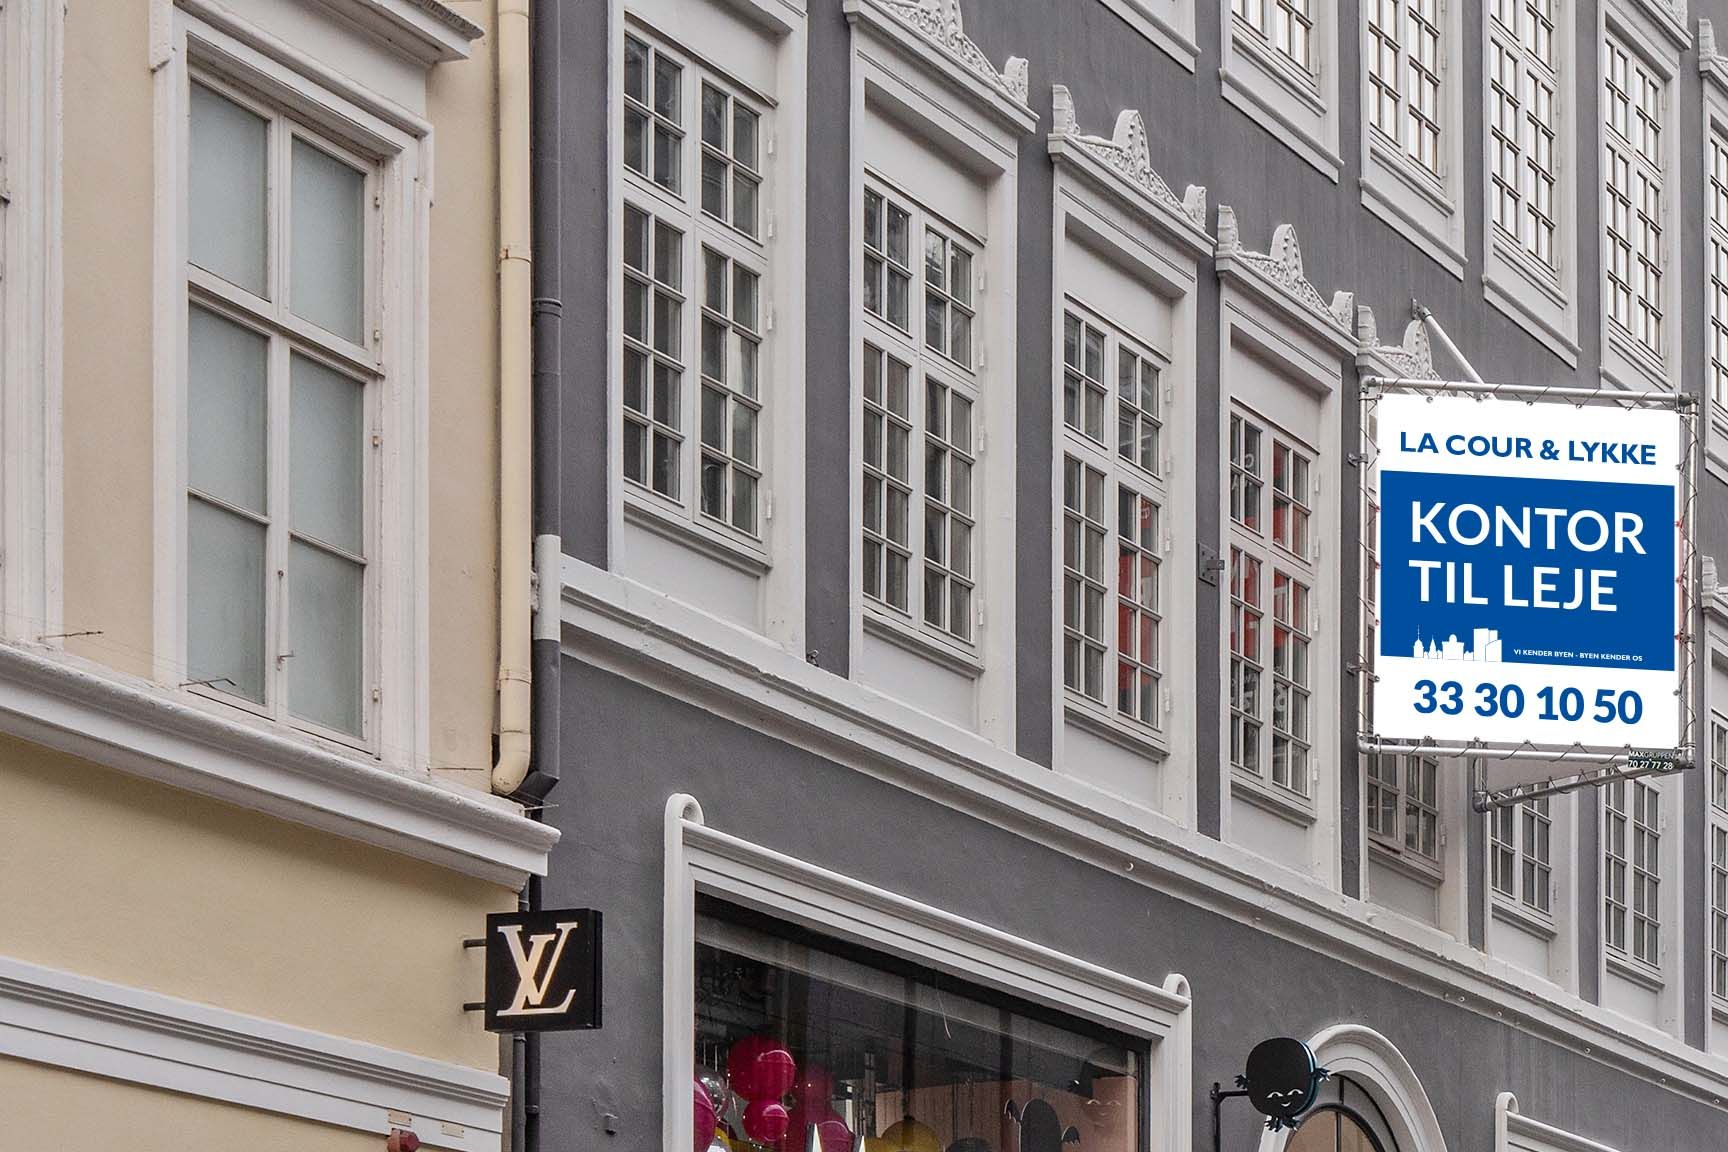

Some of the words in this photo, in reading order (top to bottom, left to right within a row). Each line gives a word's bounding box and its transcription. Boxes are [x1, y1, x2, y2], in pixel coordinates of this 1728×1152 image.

[1400, 432, 1438, 453] LA
[1446, 435, 1533, 458] COUR
[1540, 440, 1560, 460] &
[1569, 440, 1656, 465] LYKKE
[1412, 501, 1647, 554] KONTOR
[1409, 560, 1488, 604] TIL
[1504, 565, 1617, 612] LEJE
[1523, 649, 1552, 657] KENDER
[1580, 652, 1600, 660] BYEN
[1413, 680, 1464, 715] 33
[1474, 683, 1524, 718] 30
[1538, 686, 1584, 721] 10
[1593, 689, 1643, 724] 50
